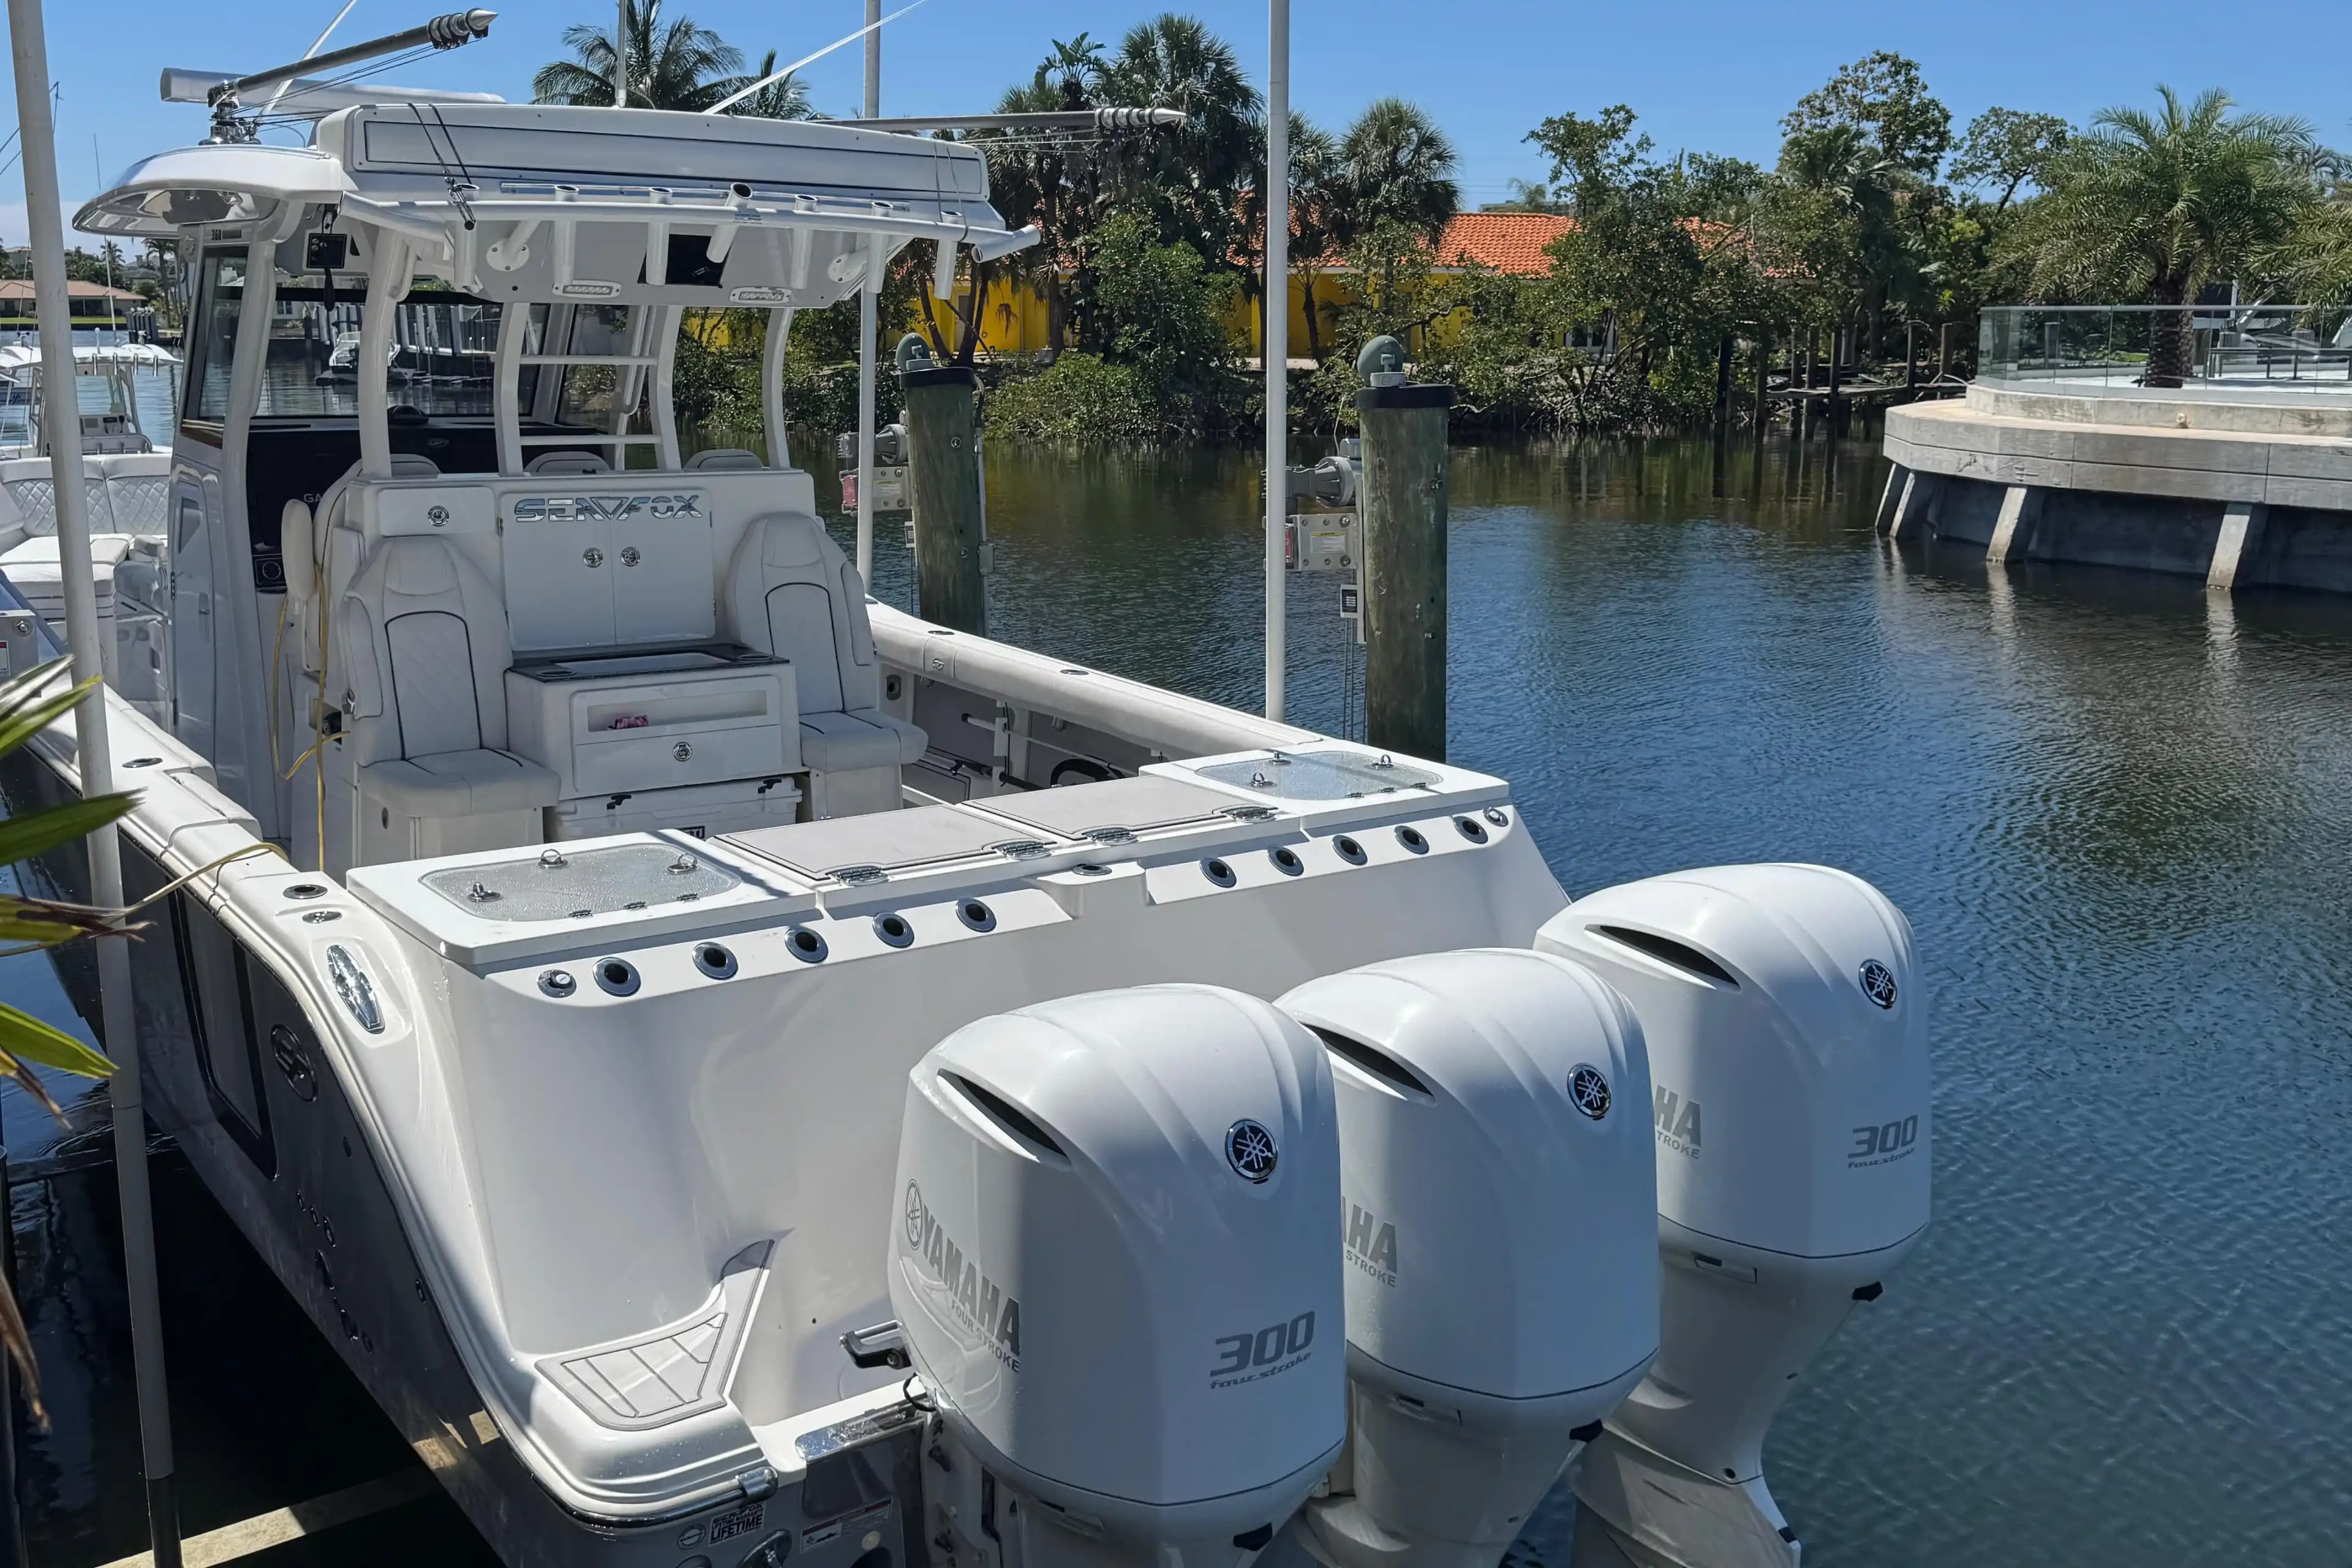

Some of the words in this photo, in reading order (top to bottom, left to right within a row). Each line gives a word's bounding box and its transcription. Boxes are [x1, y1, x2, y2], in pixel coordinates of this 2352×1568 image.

[1657, 1129, 1700, 1159] TROKE
[1848, 1115, 1918, 1159] 300
[924, 1204, 1020, 1357] YAMAHA
[1346, 1250, 1397, 1288] STROKE
[951, 1298, 973, 1333] FOUR
[976, 1328, 1020, 1373] STROKE
[1210, 1311, 1315, 1377] 300
[710, 1513, 763, 1541] LIFETIME
